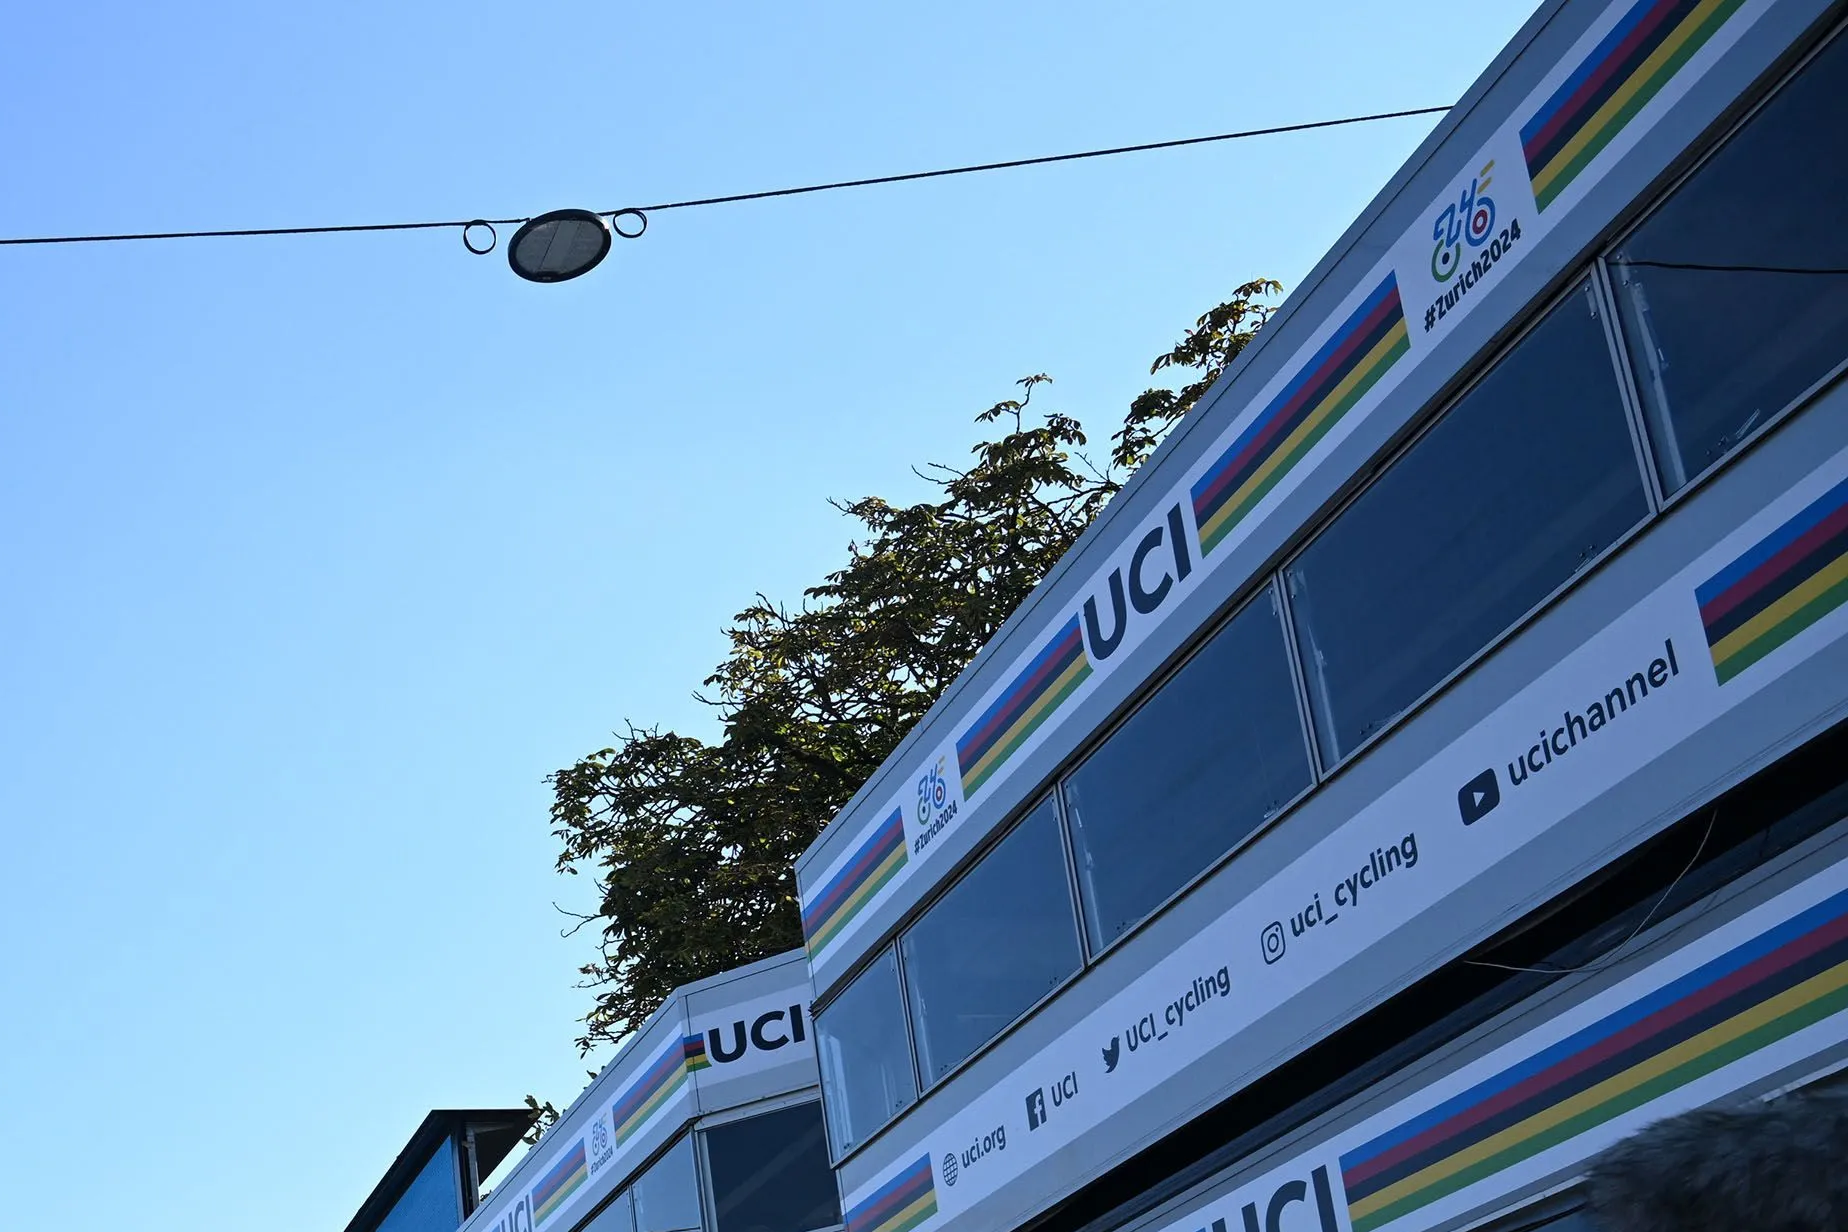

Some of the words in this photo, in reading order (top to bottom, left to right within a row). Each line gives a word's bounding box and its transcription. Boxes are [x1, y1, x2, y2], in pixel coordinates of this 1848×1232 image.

[1423, 218, 1522, 333] #Zurich2024
[1081, 501, 1191, 662] UCI
[1507, 638, 1681, 788] ucichannel
[913, 799, 958, 855] #Zurich2024
[1290, 831, 1420, 940] uci_cycling
[708, 1003, 806, 1063] UCI
[1124, 963, 1232, 1054] UCI_cycling
[1050, 1070, 1079, 1109] UCI
[960, 1123, 1007, 1171] uci.org
